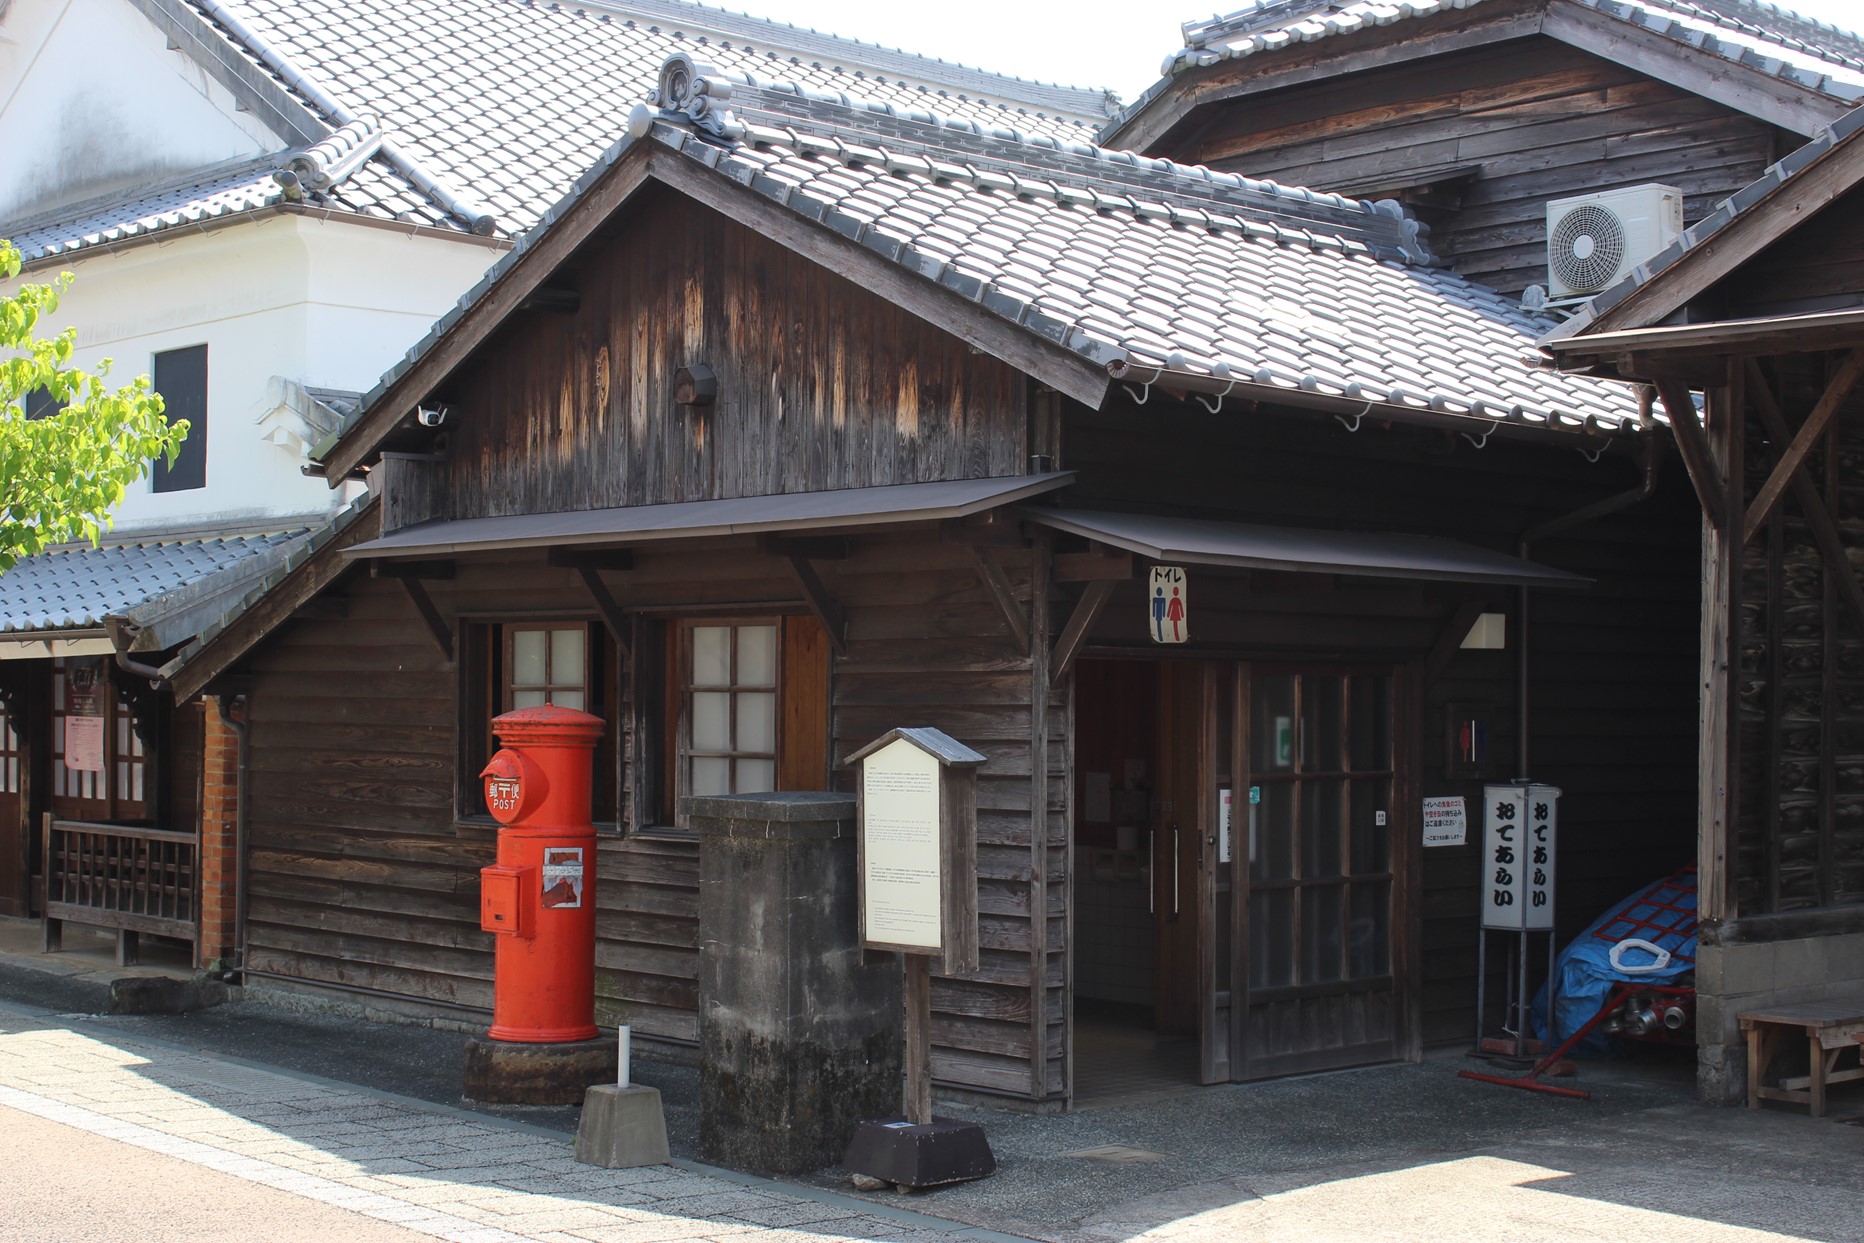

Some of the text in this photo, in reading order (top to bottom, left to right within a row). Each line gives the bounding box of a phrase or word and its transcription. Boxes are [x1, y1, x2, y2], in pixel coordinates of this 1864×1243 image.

[1155, 567, 1182, 583] トイレ
[493, 799, 515, 810] POST
[1494, 802, 1515, 906] おてあらい
[1532, 802, 1548, 907] おてあらい
